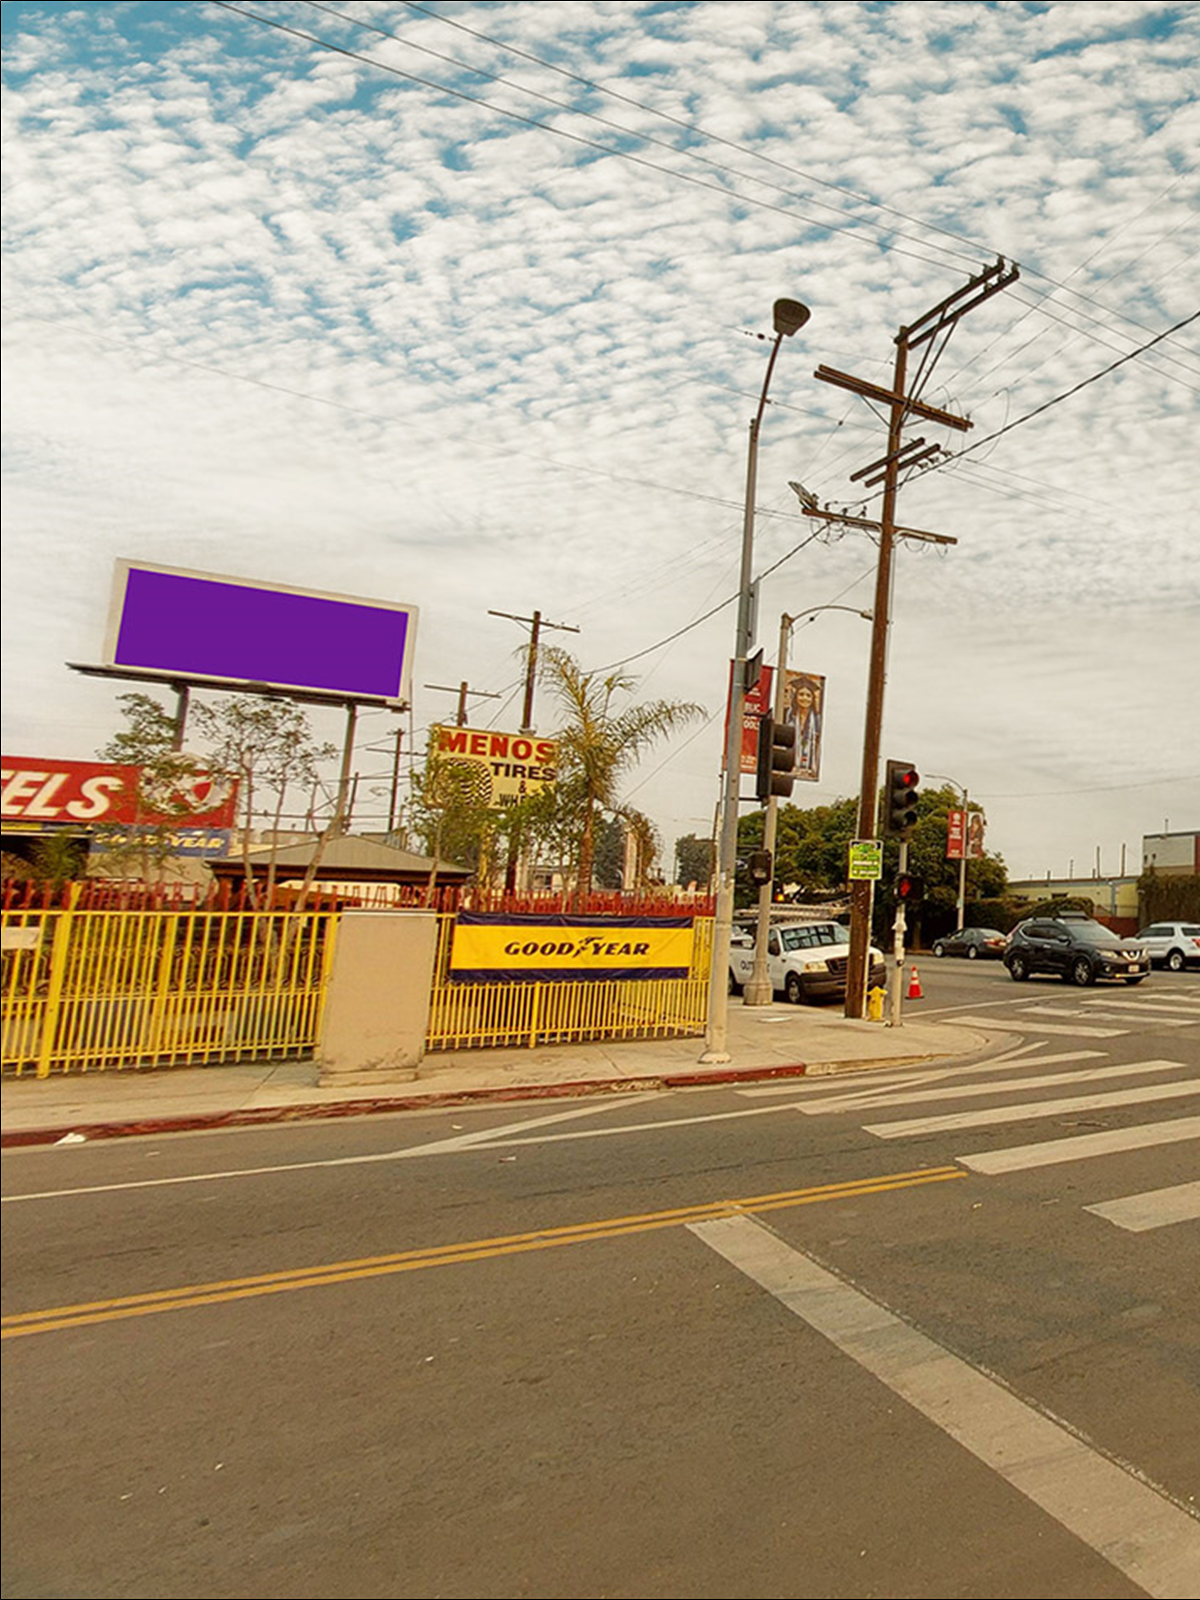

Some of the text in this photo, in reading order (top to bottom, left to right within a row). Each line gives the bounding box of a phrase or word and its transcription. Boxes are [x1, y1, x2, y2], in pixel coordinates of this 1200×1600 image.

[438, 730, 554, 762] MENOS
[490, 762, 556, 781] TIRES
[1, 769, 124, 819] ELS
[504, 941, 650, 956] GOODYEAR
